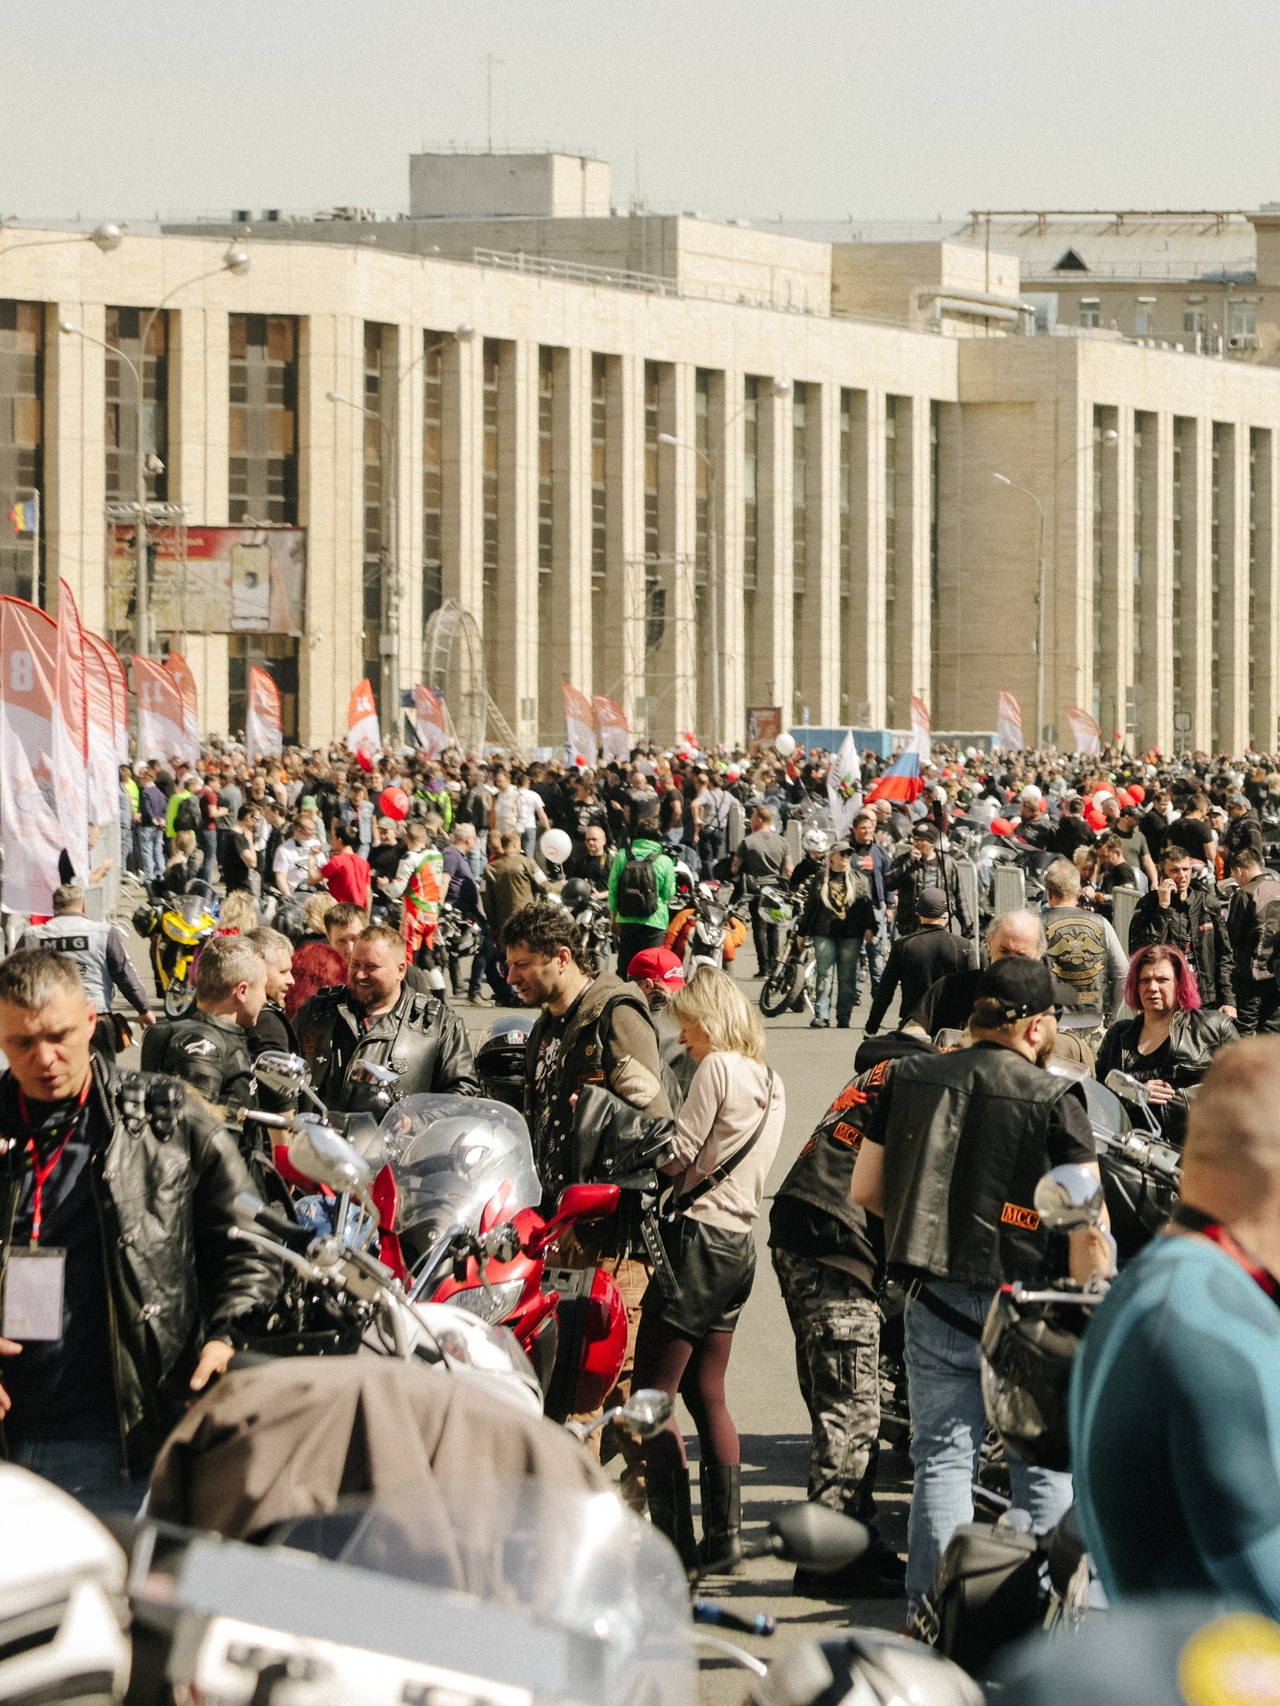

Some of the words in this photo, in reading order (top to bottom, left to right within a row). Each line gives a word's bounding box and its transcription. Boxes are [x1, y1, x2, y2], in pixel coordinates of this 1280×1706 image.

[10, 651, 34, 692] 8
[44, 937, 85, 949] MIG
[1003, 1206, 1038, 1227] MCC
